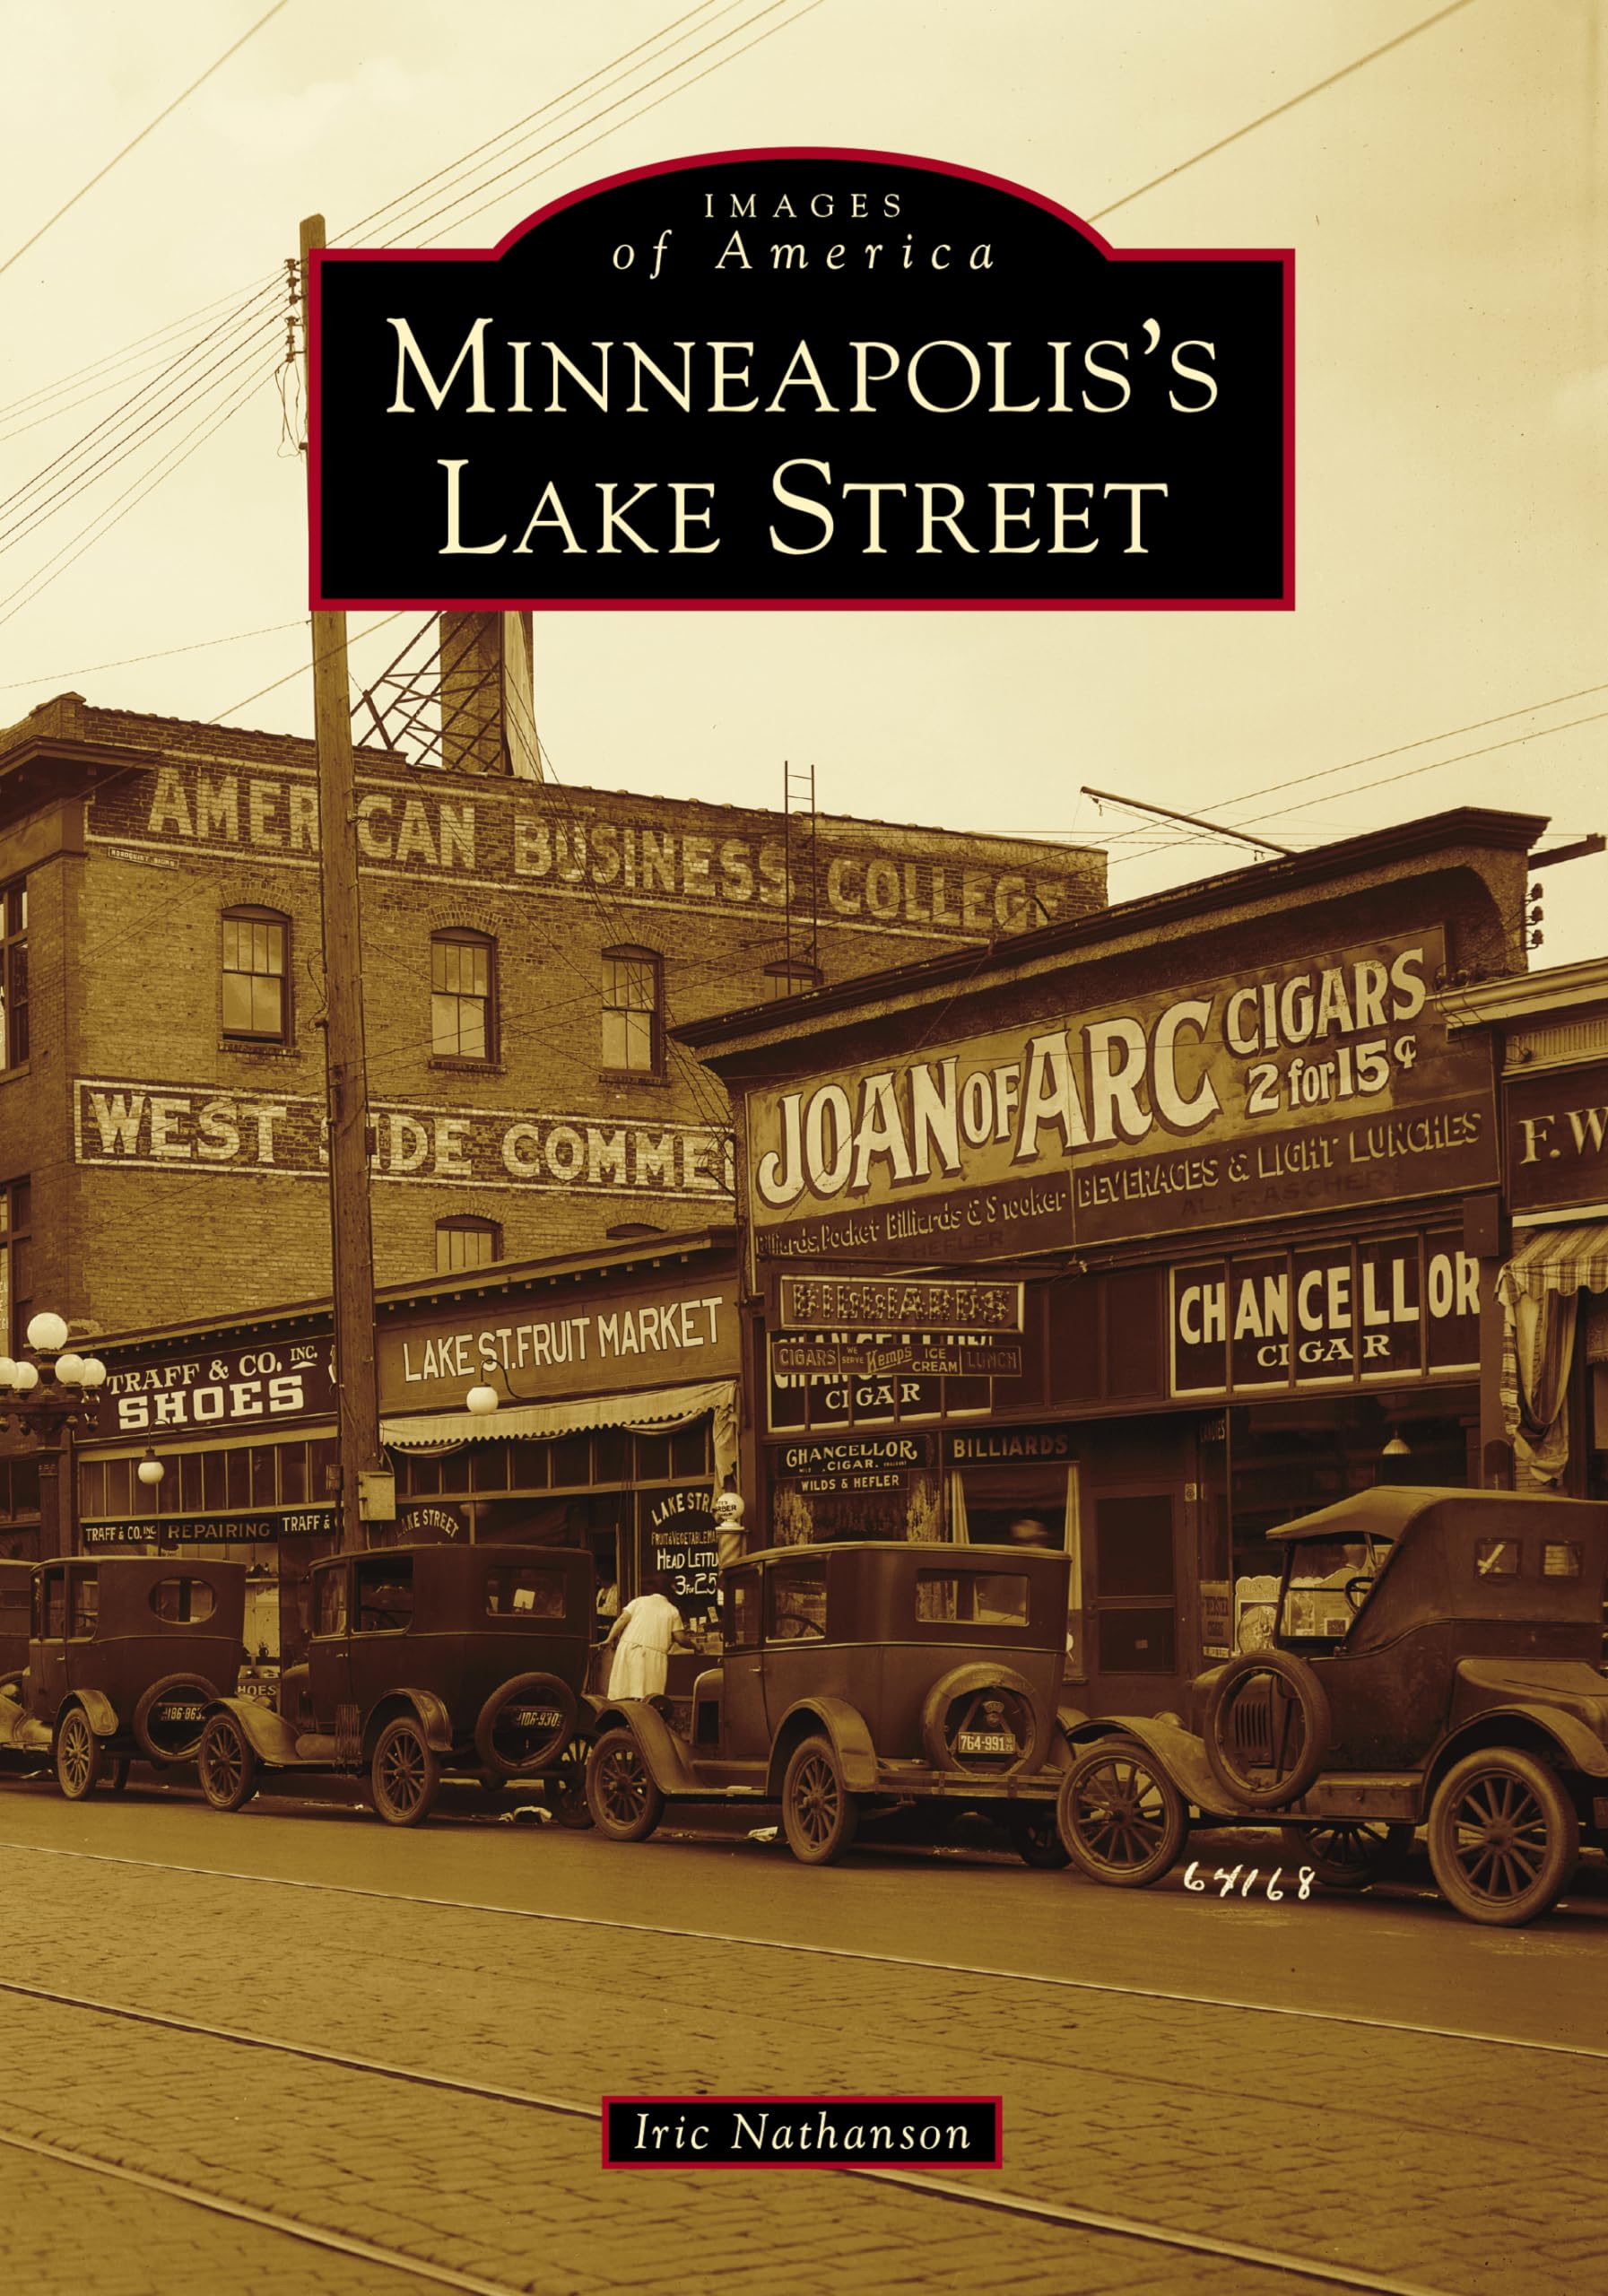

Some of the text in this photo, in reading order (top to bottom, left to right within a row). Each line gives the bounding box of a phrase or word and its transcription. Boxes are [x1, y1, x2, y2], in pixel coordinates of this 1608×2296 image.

[147, 766, 1067, 934] AMERCAN BUSINESS COLLEGE
[1226, 948, 1427, 1055] CIGARS
[1247, 1063, 1281, 1114] 2
[1288, 1058, 1336, 1106] for
[758, 1000, 1221, 1204] JOAN OF ARC
[89, 1091, 287, 1163] WEST
[318, 1112, 473, 1177] DE
[1077, 1112, 1482, 1208] BEVERAGES & LIGHT LUNCHES
[821, 1219, 881, 1251] Pocket
[886, 1199, 963, 1240] Billiards
[967, 1199, 983, 1226] &
[986, 1185, 1068, 1224] Snooker
[793, 1283, 1010, 1323] BILLIARDS
[1178, 1250, 1481, 1345] CHANCELLOR
[404, 1334, 475, 1382] LAKE
[517, 1318, 590, 1369] FRUIT
[597, 1296, 724, 1359] MARKET
[847, 1346, 859, 1355] WE
[925, 1348, 947, 1360] ICE
[1256, 1333, 1392, 1368] CIGAR
[107, 1344, 318, 1396] TRAFF & CO. INC.
[778, 1348, 838, 1368] CIGARS
[841, 1356, 865, 1365] SERVE
[911, 1361, 959, 1373] CREAM
[966, 1351, 1018, 1370] LUNCH
[117, 1375, 305, 1430] SHOES
[825, 1382, 921, 1411] CIGAR
[786, 1439, 918, 1468] CHANCELLOR
[952, 1435, 1069, 1459] BILLIARDS
[801, 1474, 900, 1492] WILDS & HEFLER
[282, 1514, 321, 1533] TRAFF
[422, 1508, 460, 1539] STREET
[651, 1492, 714, 1526] LAKE STR
[85, 1526, 117, 1542] TRAFF
[117, 1526, 125, 1541] &
[127, 1526, 143, 1540] CO.
[169, 1522, 270, 1540] REPAIRING
[960, 1735, 1005, 1752] 764-991
